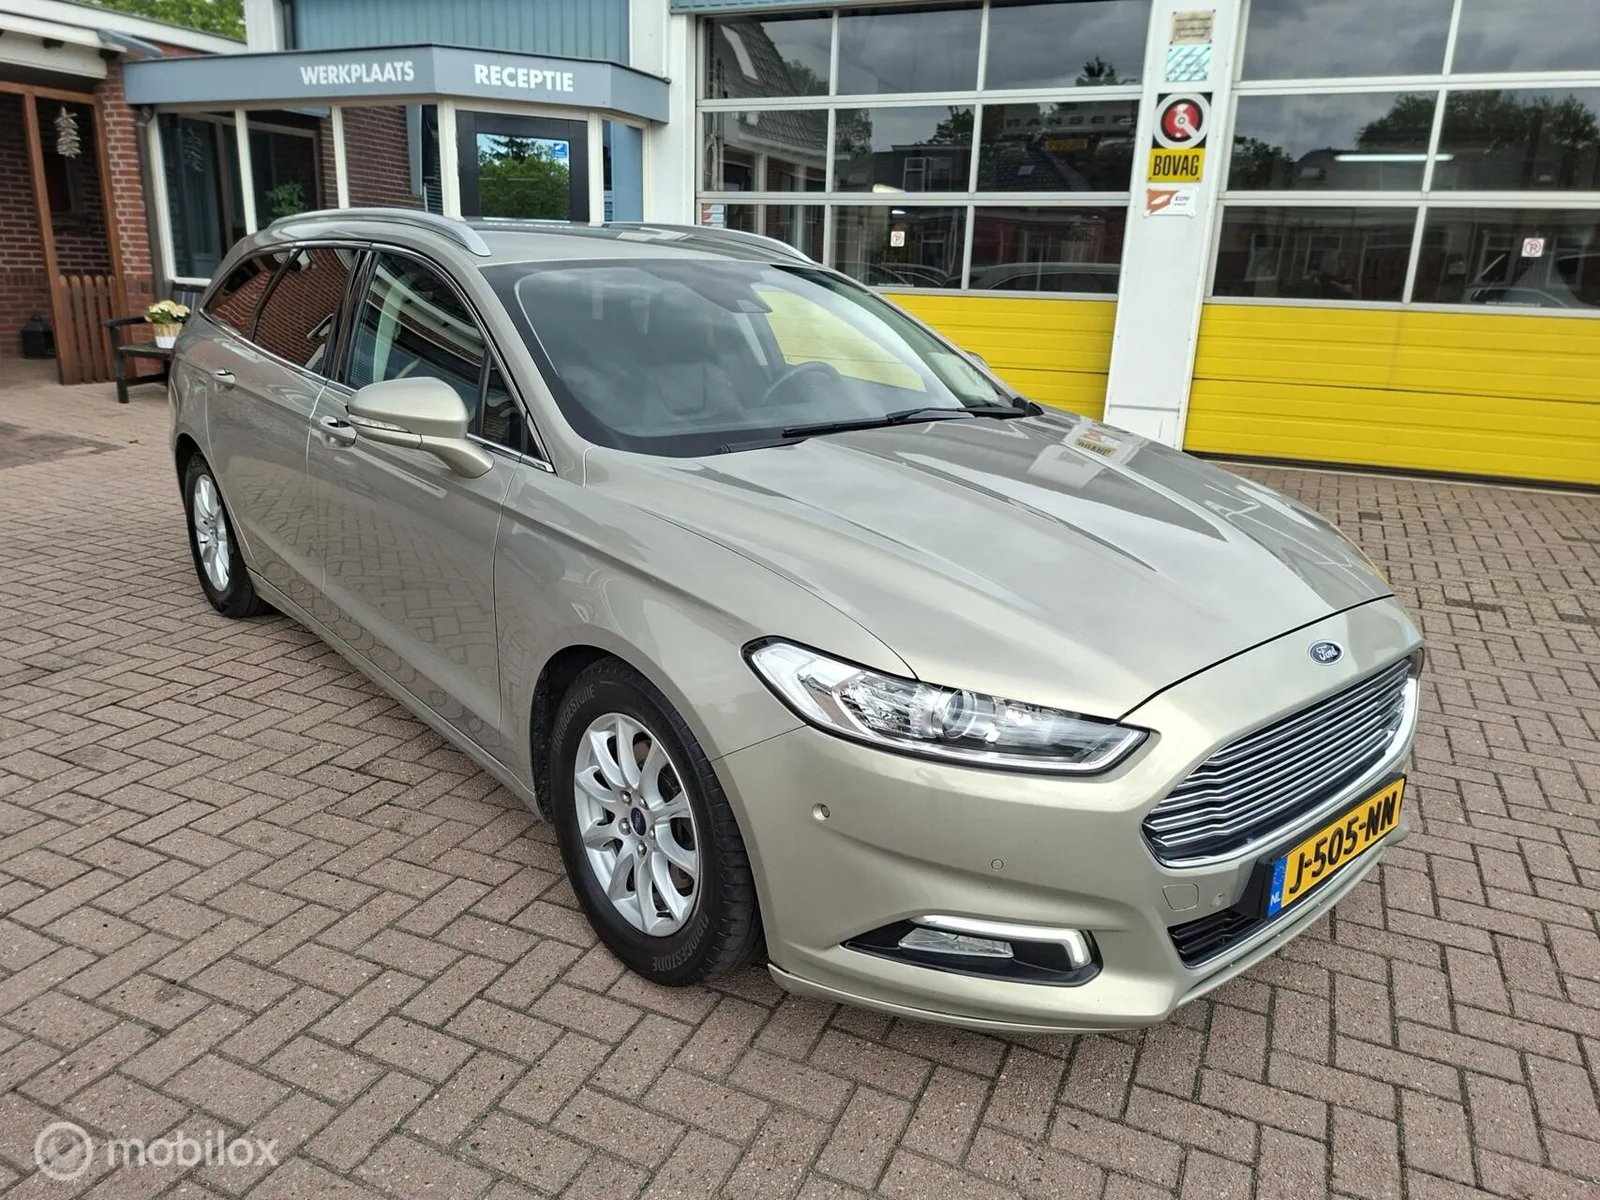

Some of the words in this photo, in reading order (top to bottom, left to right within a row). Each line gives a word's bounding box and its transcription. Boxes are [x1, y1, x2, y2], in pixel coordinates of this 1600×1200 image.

[300, 61, 414, 86] WERKPLAATS
[474, 63, 574, 92] RECEPTIE
[1153, 154, 1200, 177] BOVAG
[1315, 645, 1338, 660] Ford
[1288, 790, 1398, 894] J-505-NN
[1270, 890, 1281, 906] NL
